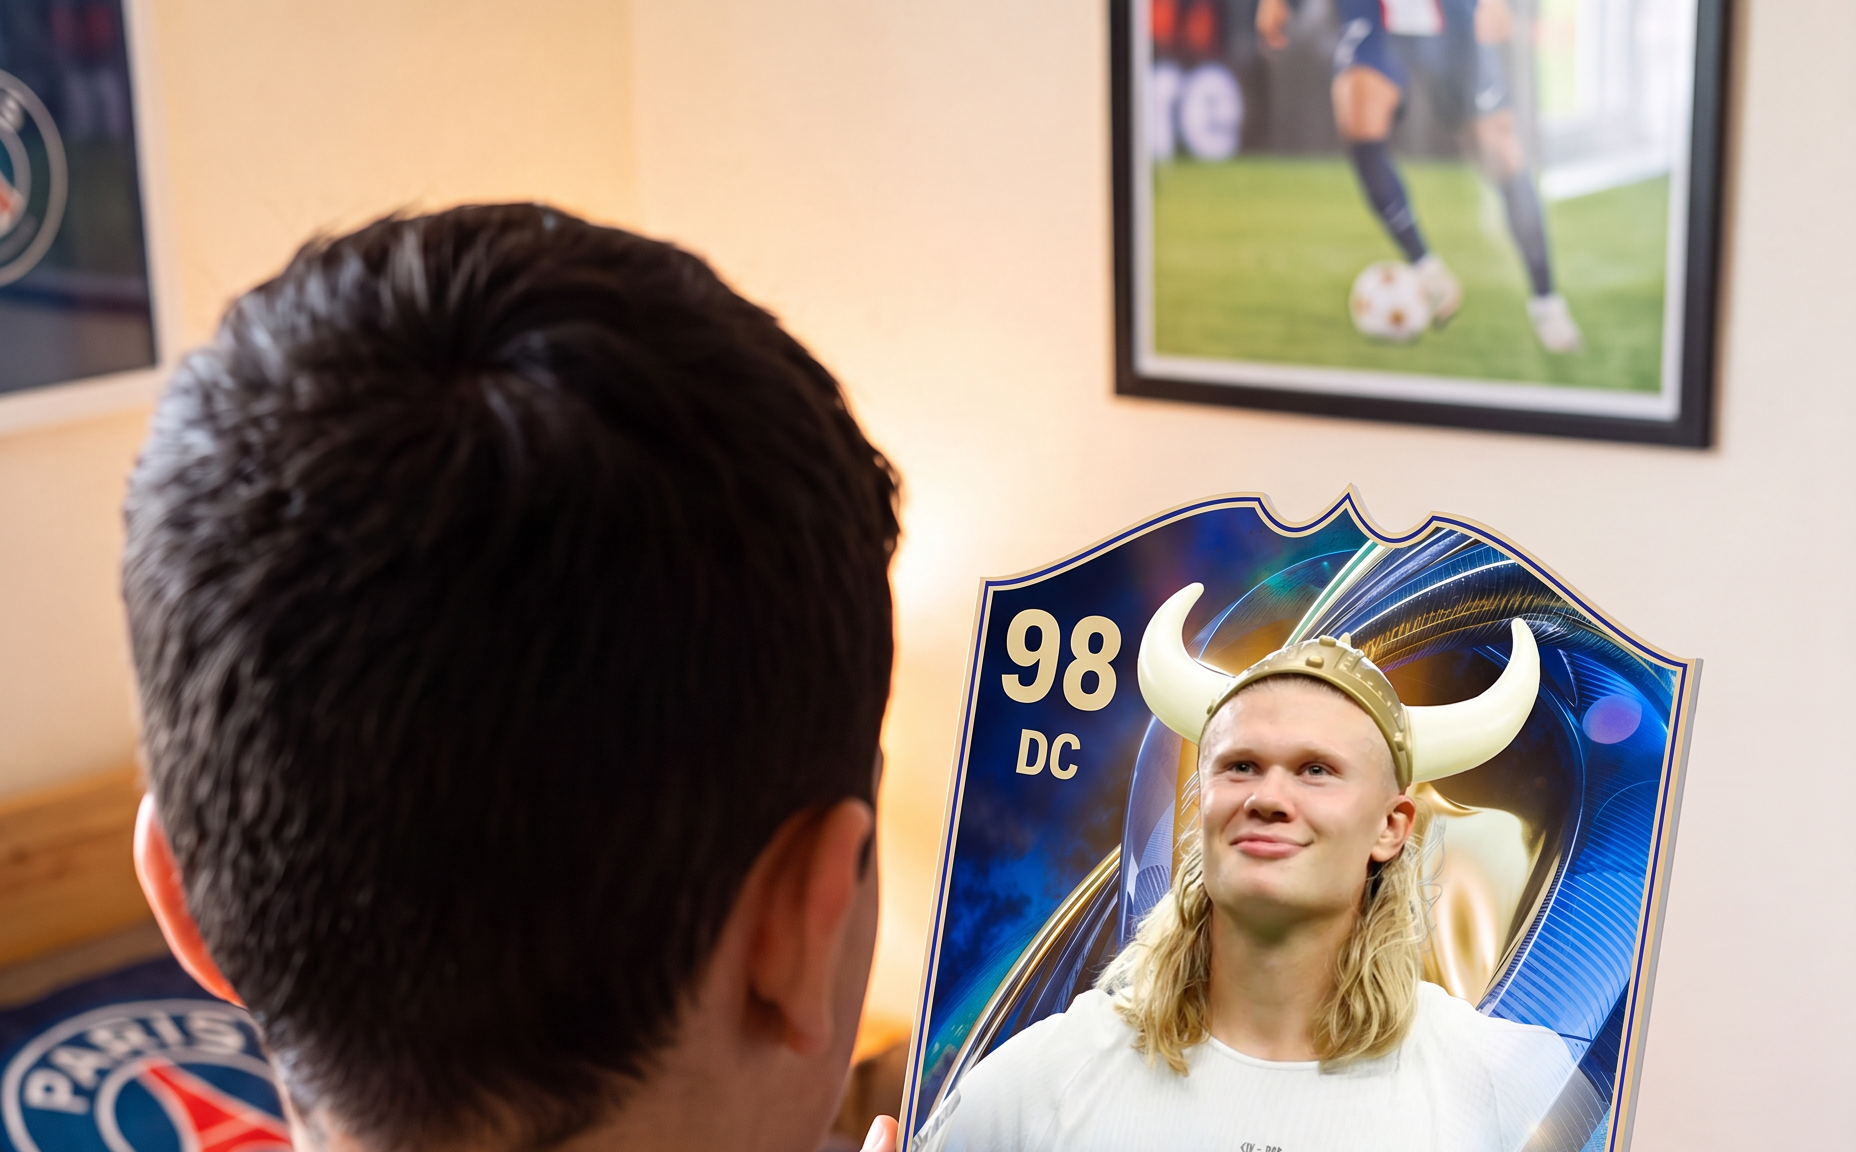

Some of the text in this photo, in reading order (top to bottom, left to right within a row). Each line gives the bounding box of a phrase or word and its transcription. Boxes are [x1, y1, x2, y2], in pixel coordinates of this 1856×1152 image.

[1002, 608, 1122, 712] 98
[1016, 728, 1081, 780] DC
[24, 1009, 246, 1116] PARIS
